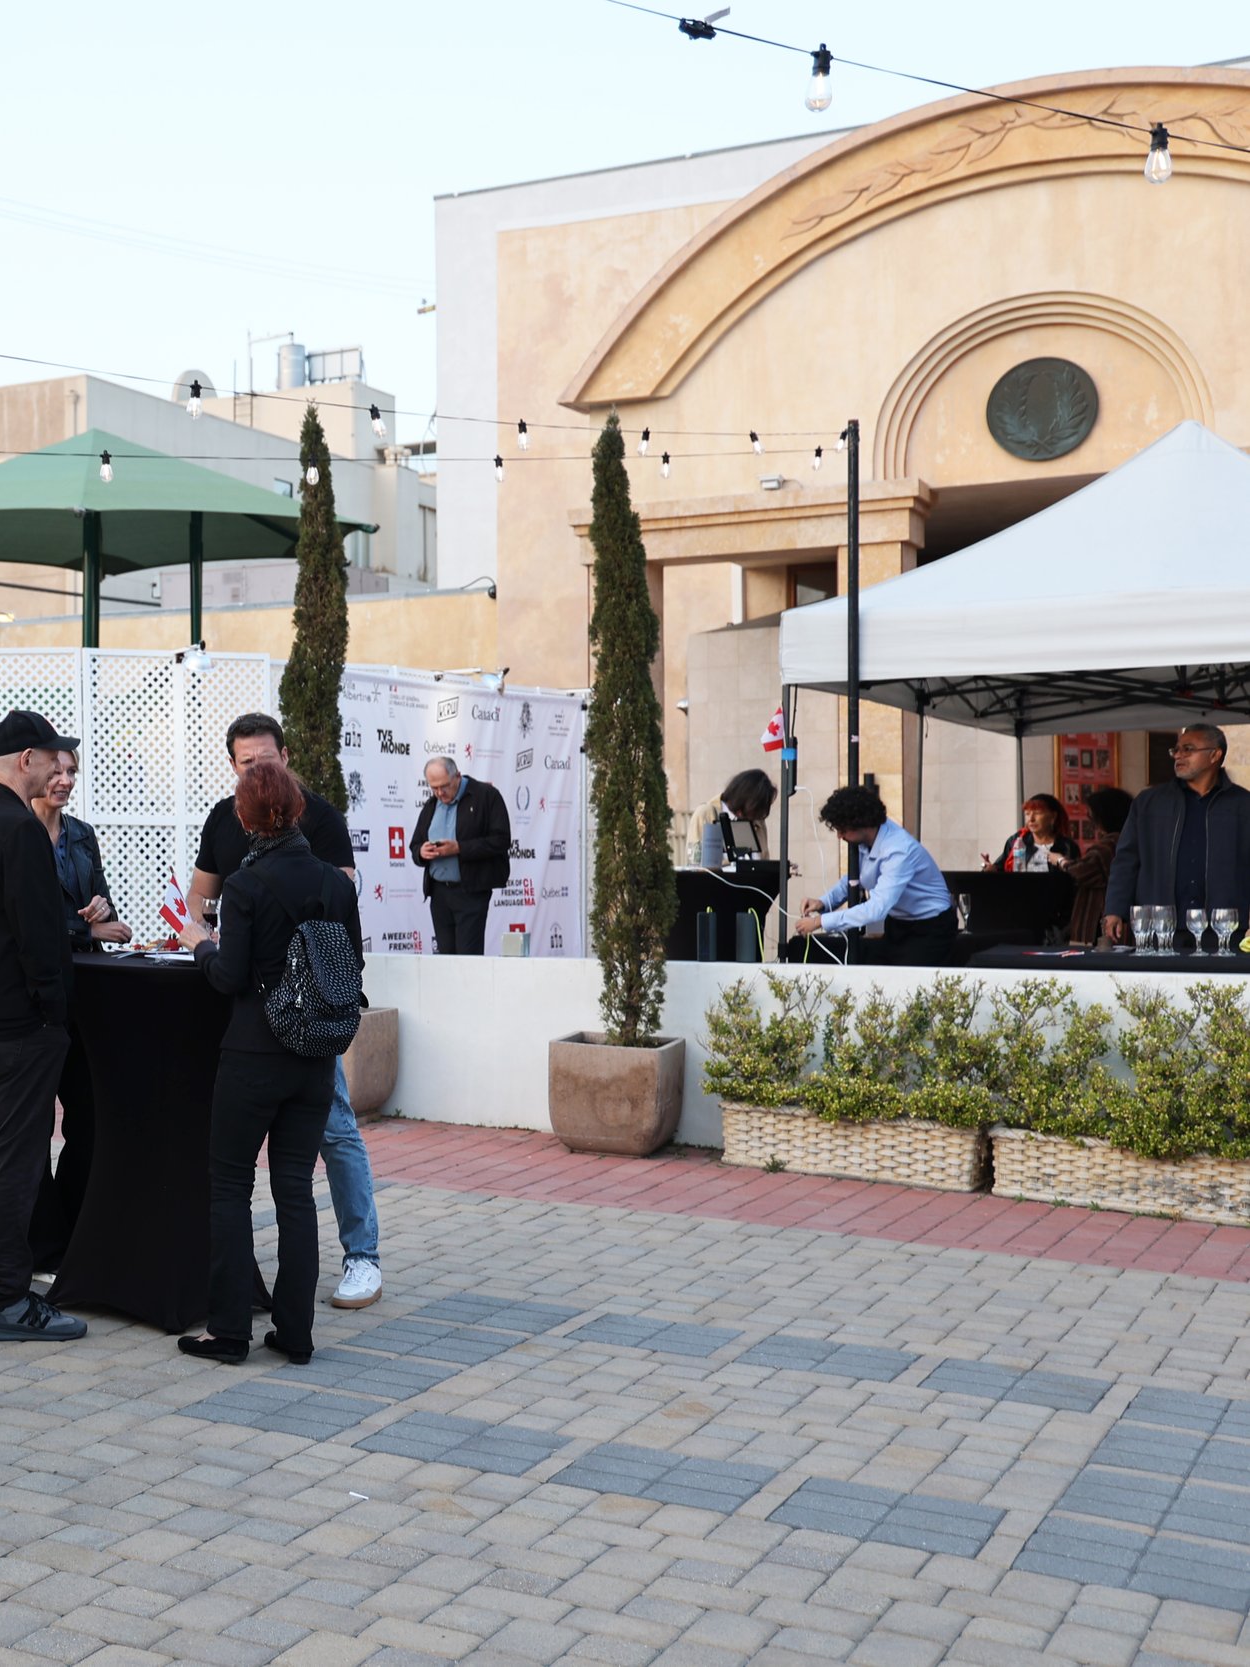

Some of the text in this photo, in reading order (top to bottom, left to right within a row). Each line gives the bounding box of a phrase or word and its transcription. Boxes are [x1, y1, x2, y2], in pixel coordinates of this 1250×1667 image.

[377, 729, 393, 742] TV5
[380, 741, 410, 755] MONDE
[501, 888, 523, 896] FRENCH
[494, 898, 524, 907] LANGUAGE
[382, 932, 387, 940] A
[388, 932, 406, 940] WEEK
[389, 942, 413, 951] FRENCH
